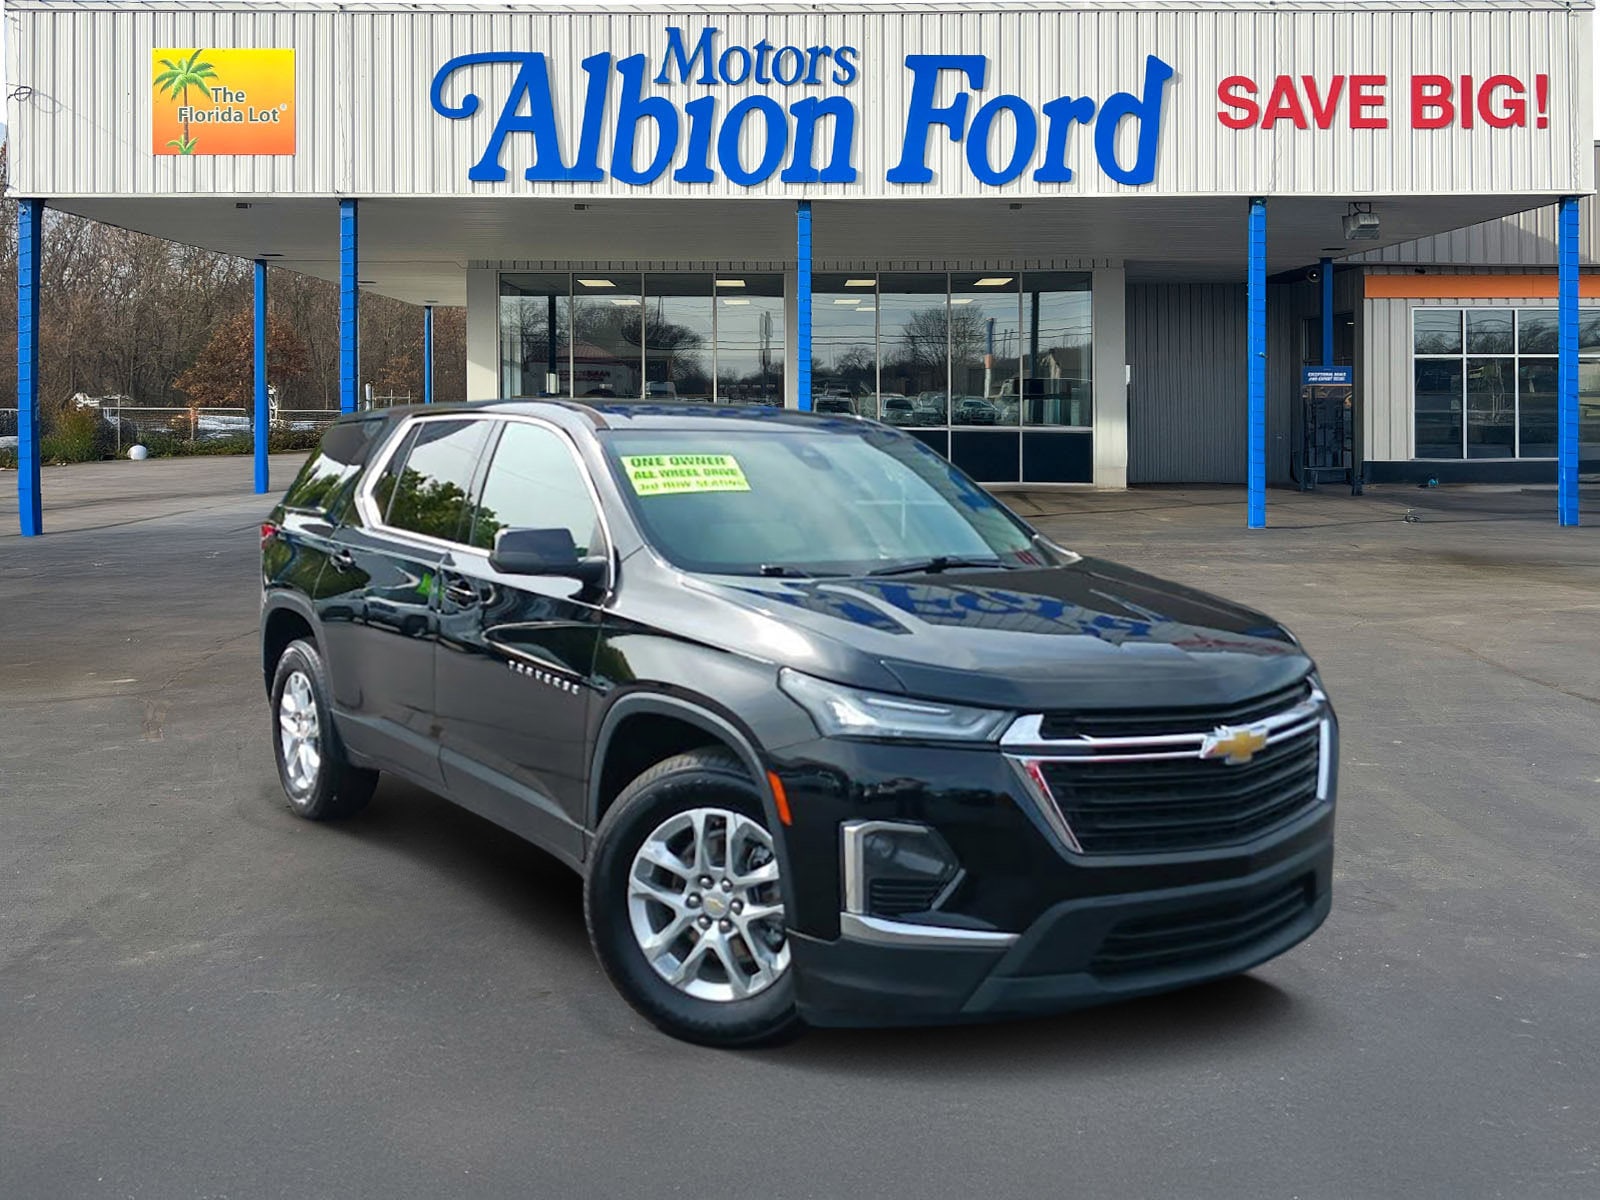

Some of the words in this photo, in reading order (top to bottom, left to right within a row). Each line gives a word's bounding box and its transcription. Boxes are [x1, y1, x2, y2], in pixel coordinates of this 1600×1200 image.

[655, 28, 857, 85] Motors
[211, 87, 245, 103] The
[1218, 75, 1387, 129] SAVE
[1412, 75, 1548, 129] BIG!
[178, 107, 243, 122] Florida
[249, 107, 279, 122] Lot
[431, 52, 857, 185] Albion
[887, 54, 1174, 185] Ford
[631, 456, 666, 467] ONE
[669, 455, 726, 467] OWNER
[634, 470, 658, 480] ALL
[659, 468, 701, 479] WHEEL
[703, 467, 737, 477] DRIVE
